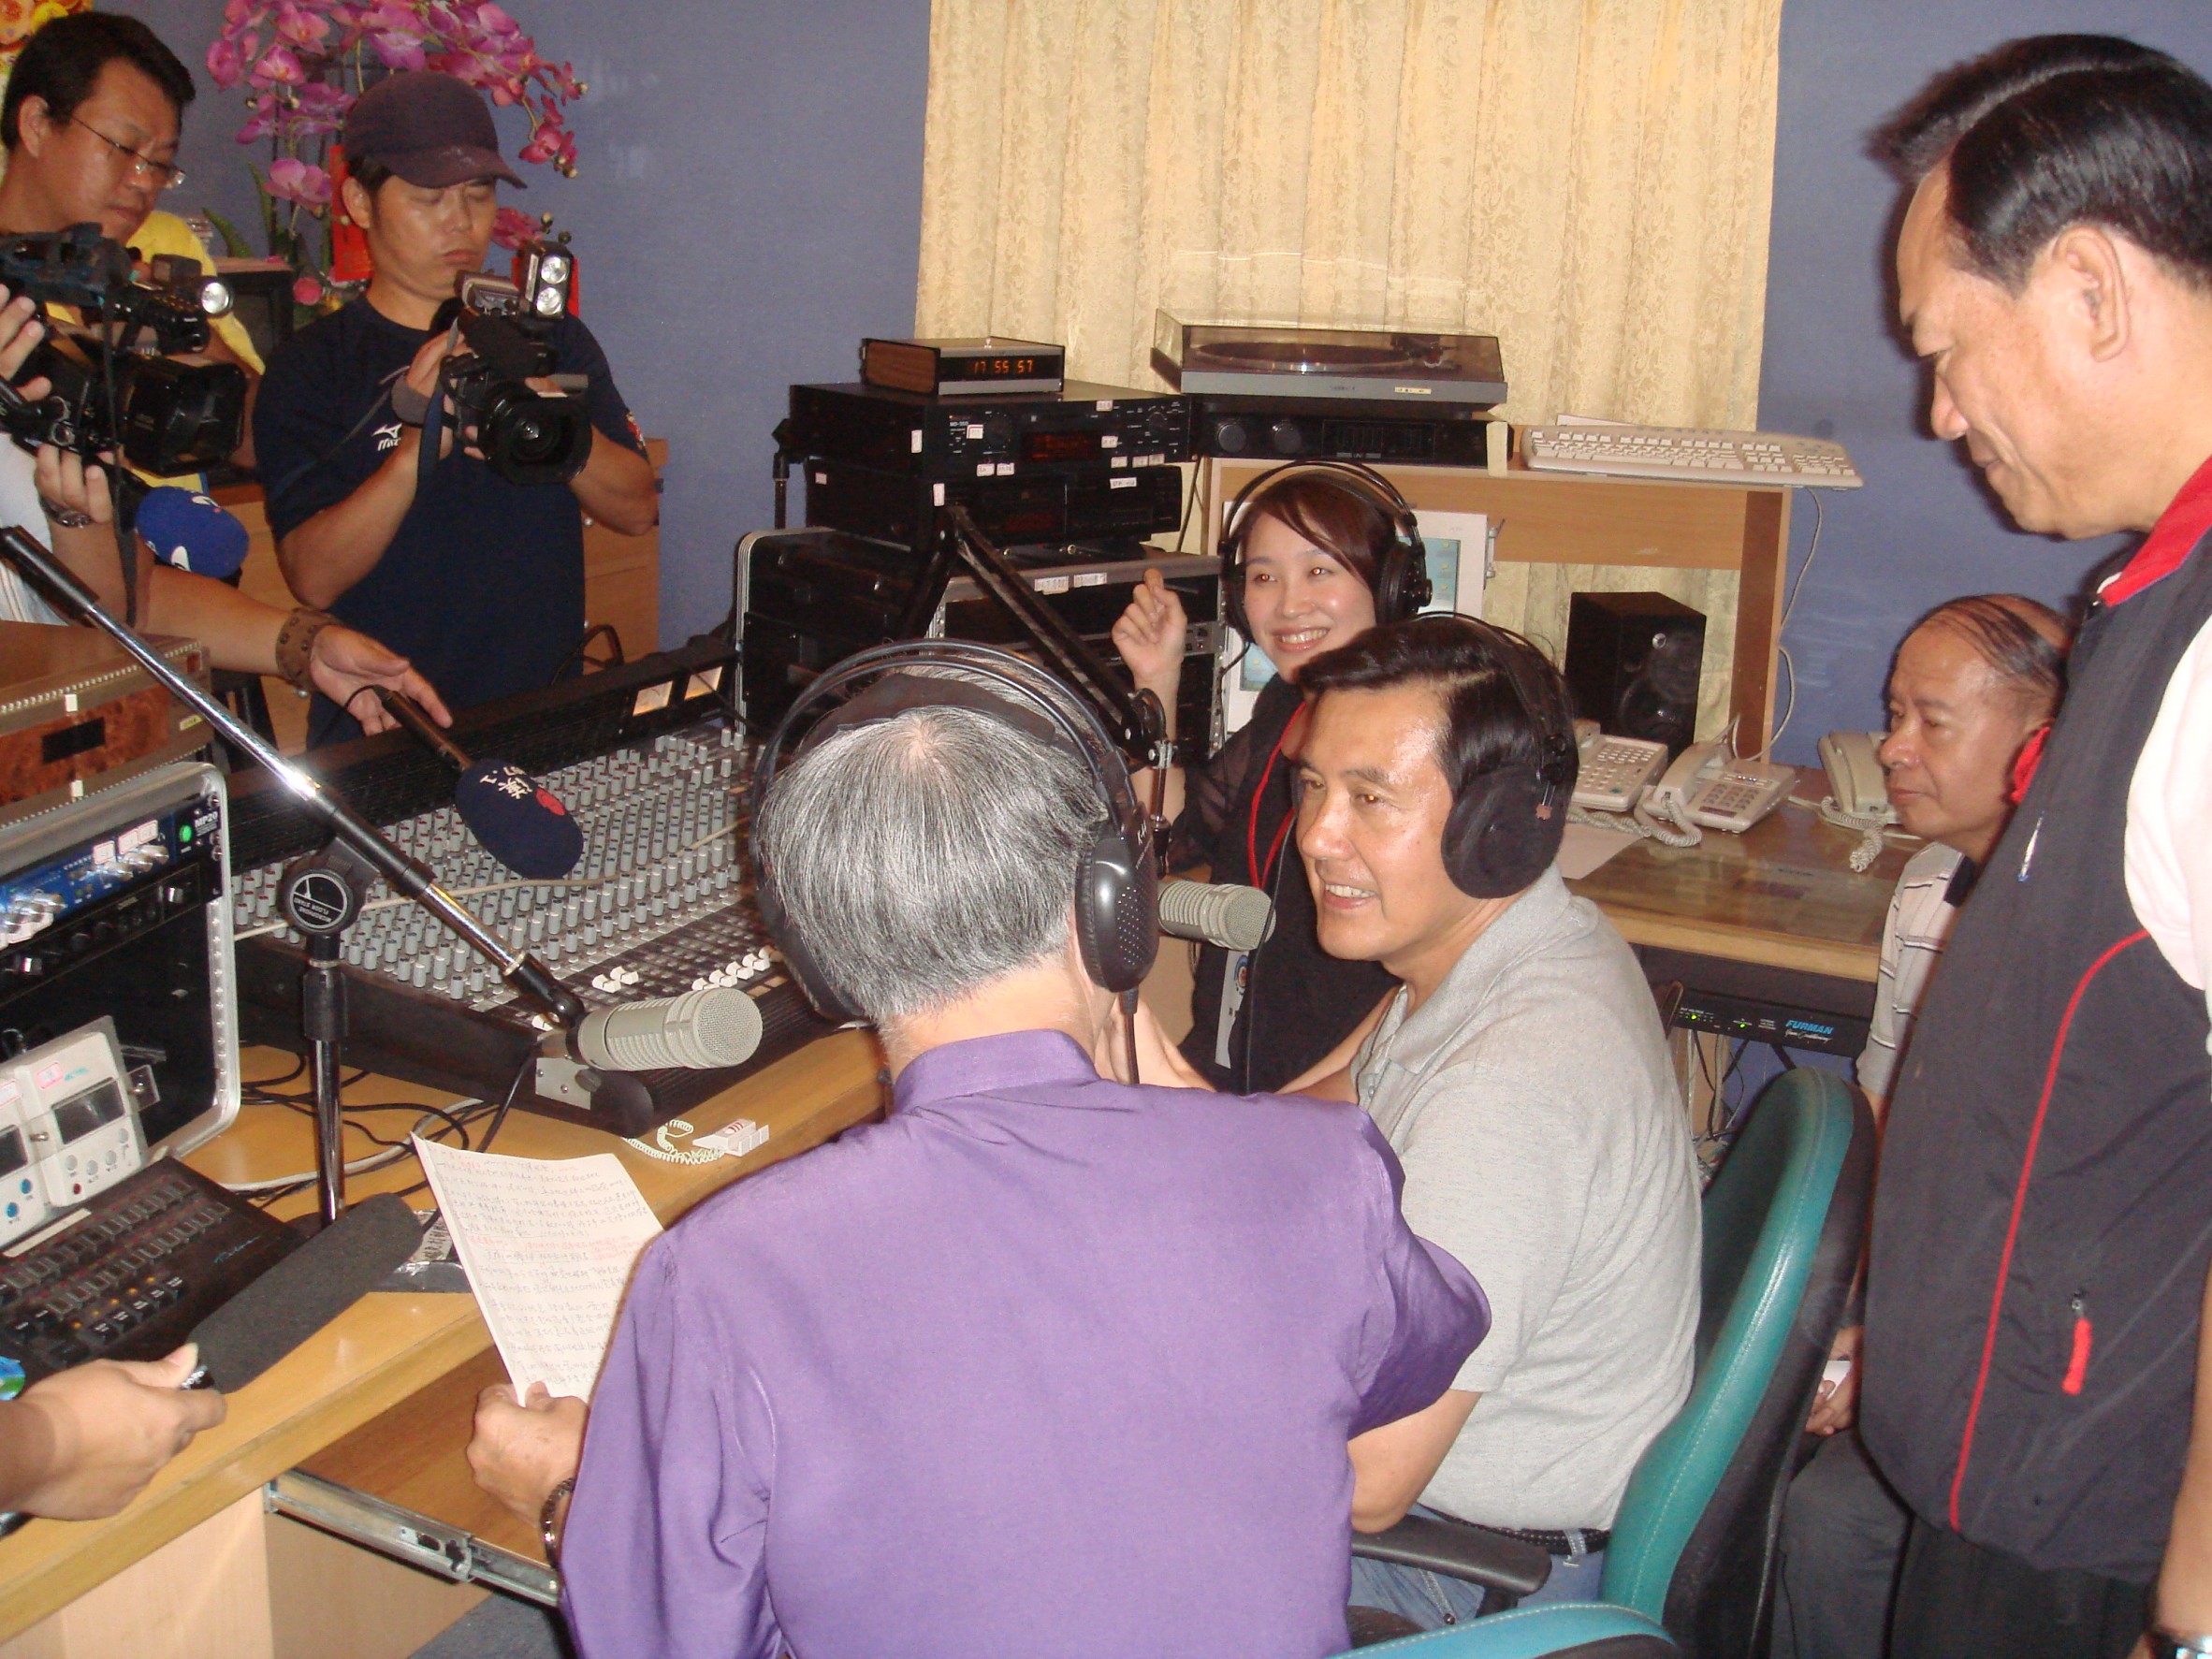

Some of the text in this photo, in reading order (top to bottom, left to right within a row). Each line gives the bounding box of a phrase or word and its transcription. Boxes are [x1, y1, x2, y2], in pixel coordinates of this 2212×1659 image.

[974, 359, 1033, 373] 17 55 57
[377, 438, 401, 451] MIZ
[195, 811, 218, 828] MP20
[1785, 1020, 1834, 1035] FURMAN
